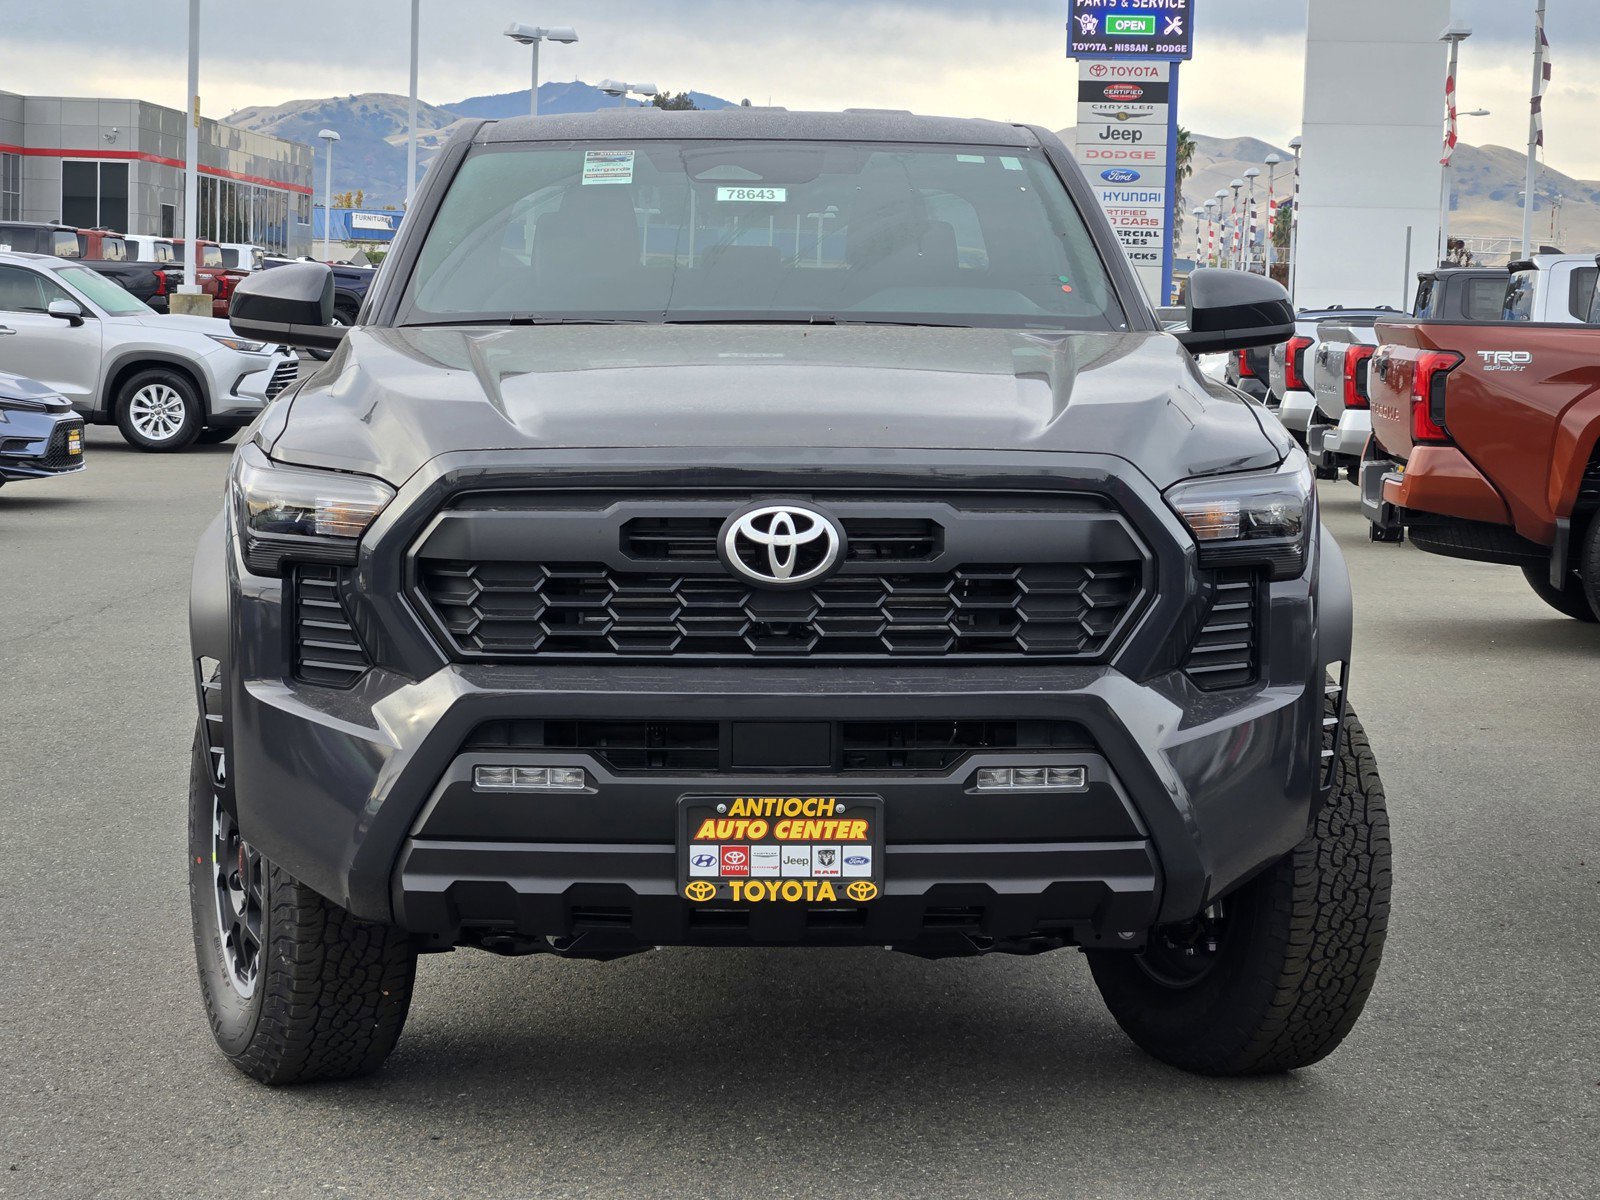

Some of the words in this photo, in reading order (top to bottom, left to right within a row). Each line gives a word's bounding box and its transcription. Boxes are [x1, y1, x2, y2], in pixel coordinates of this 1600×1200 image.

[1132, 0, 1186, 8] SERVICE
[1115, 20, 1146, 30] OPEN
[1072, 43, 1106, 51] TOYOTA
[1114, 43, 1148, 52] NISSAN
[1156, 44, 1187, 53] DODGE
[1110, 66, 1158, 76] TOYOTA
[1099, 126, 1142, 143] Jeep
[1086, 150, 1156, 159] DODGE
[1108, 170, 1132, 181] Ford
[726, 189, 776, 200] 78643
[1104, 192, 1161, 202] HYUNDAI
[1477, 350, 1532, 364] TRD
[728, 798, 836, 816] ANTIOCH
[695, 820, 768, 840] AUTO
[774, 820, 868, 840] CENTER
[783, 856, 809, 866] Jeep
[729, 880, 837, 902] TOYOTA
